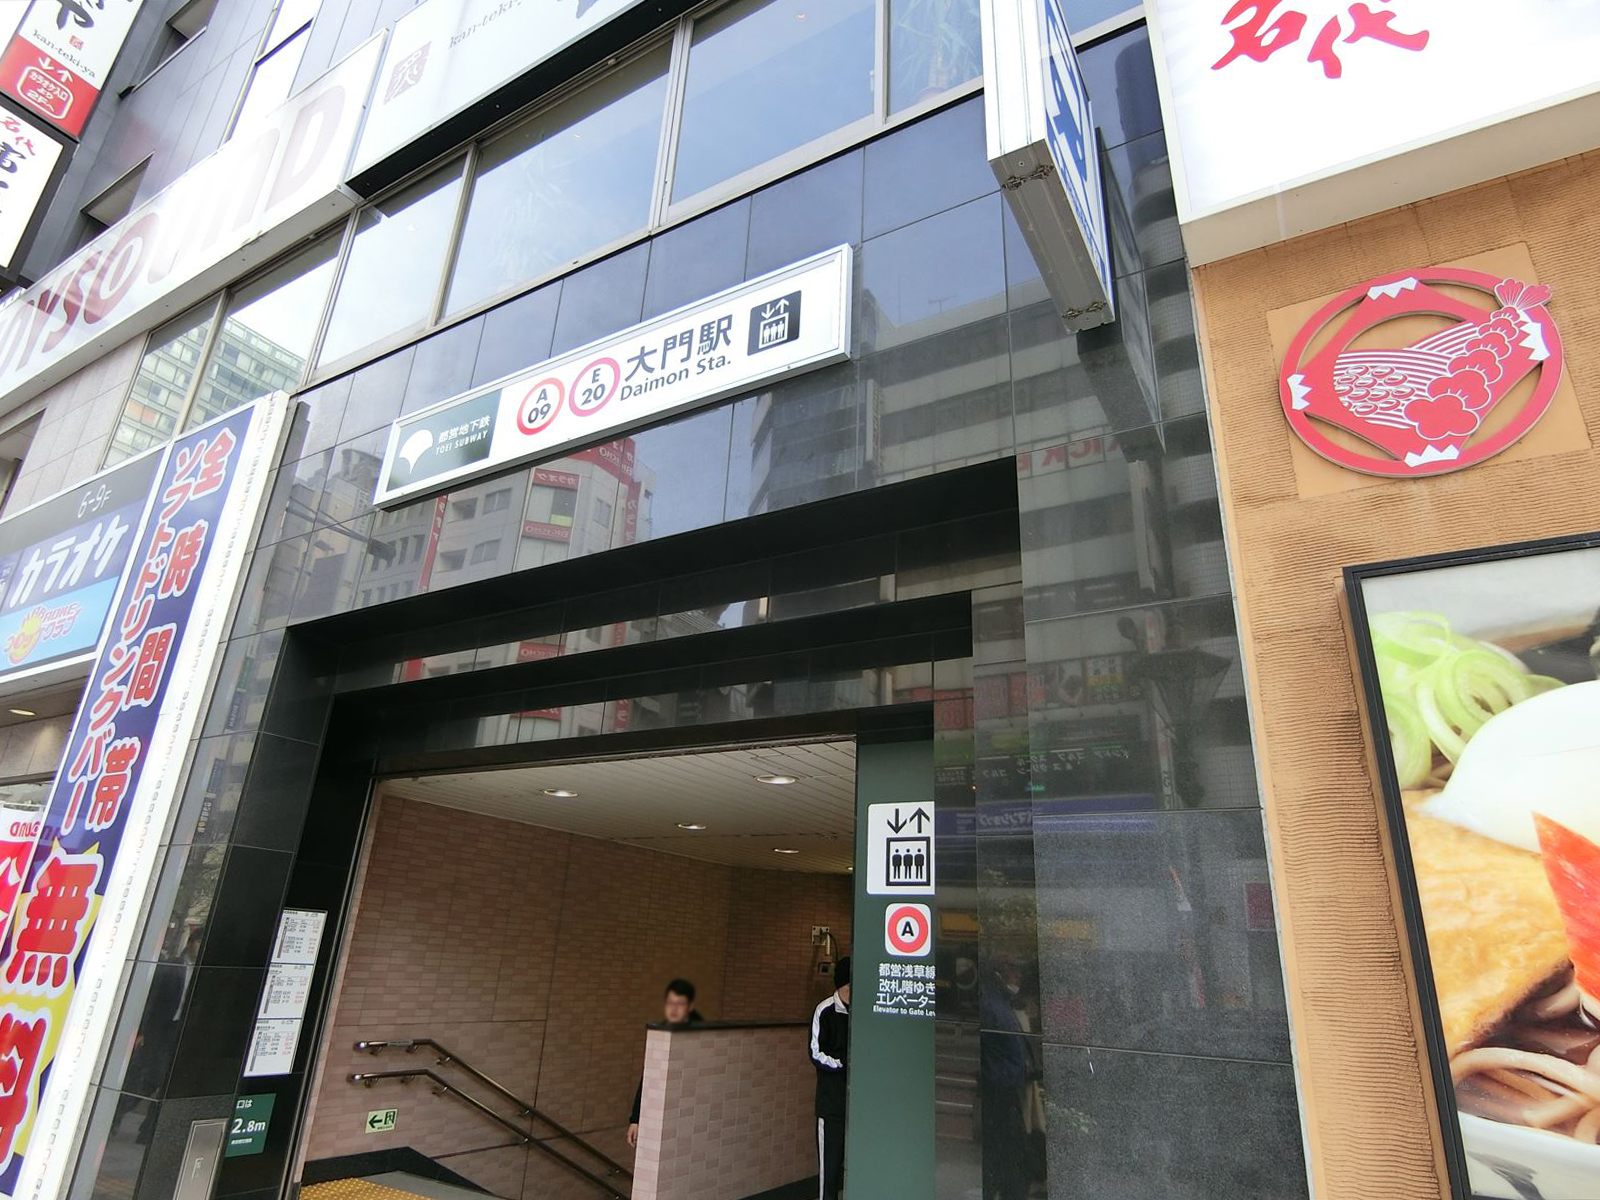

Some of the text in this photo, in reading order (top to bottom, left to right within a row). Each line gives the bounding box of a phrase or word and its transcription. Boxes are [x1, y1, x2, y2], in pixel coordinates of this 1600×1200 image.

[33, 29, 96, 78] kan-teki-ya
[624, 313, 733, 382] 大門駅
[591, 367, 602, 384] E
[619, 354, 732, 401] Daimon Sta.
[535, 388, 548, 404] A
[581, 383, 606, 406] 20
[527, 403, 552, 424] 09
[438, 414, 492, 443] 都営地下鉄
[435, 430, 489, 456] TOEI SUBWAY
[77, 484, 112, 518] 6-9F
[9, 514, 130, 608] カラオケ
[61, 438, 208, 836] ソフトドリンクバー
[86, 427, 237, 834] 全時間帯
[901, 921, 915, 937] A
[879, 963, 936, 979] 都営浅草線
[879, 979, 936, 995] 改札階ゆき
[873, 1004, 899, 1014] Elevator
[900, 1007, 907, 1015] to
[909, 1007, 925, 1016] Gate
[876, 992, 936, 1009] エレベーター
[236, 1099, 254, 1109] 口は
[230, 1117, 267, 1134] 2.8m
